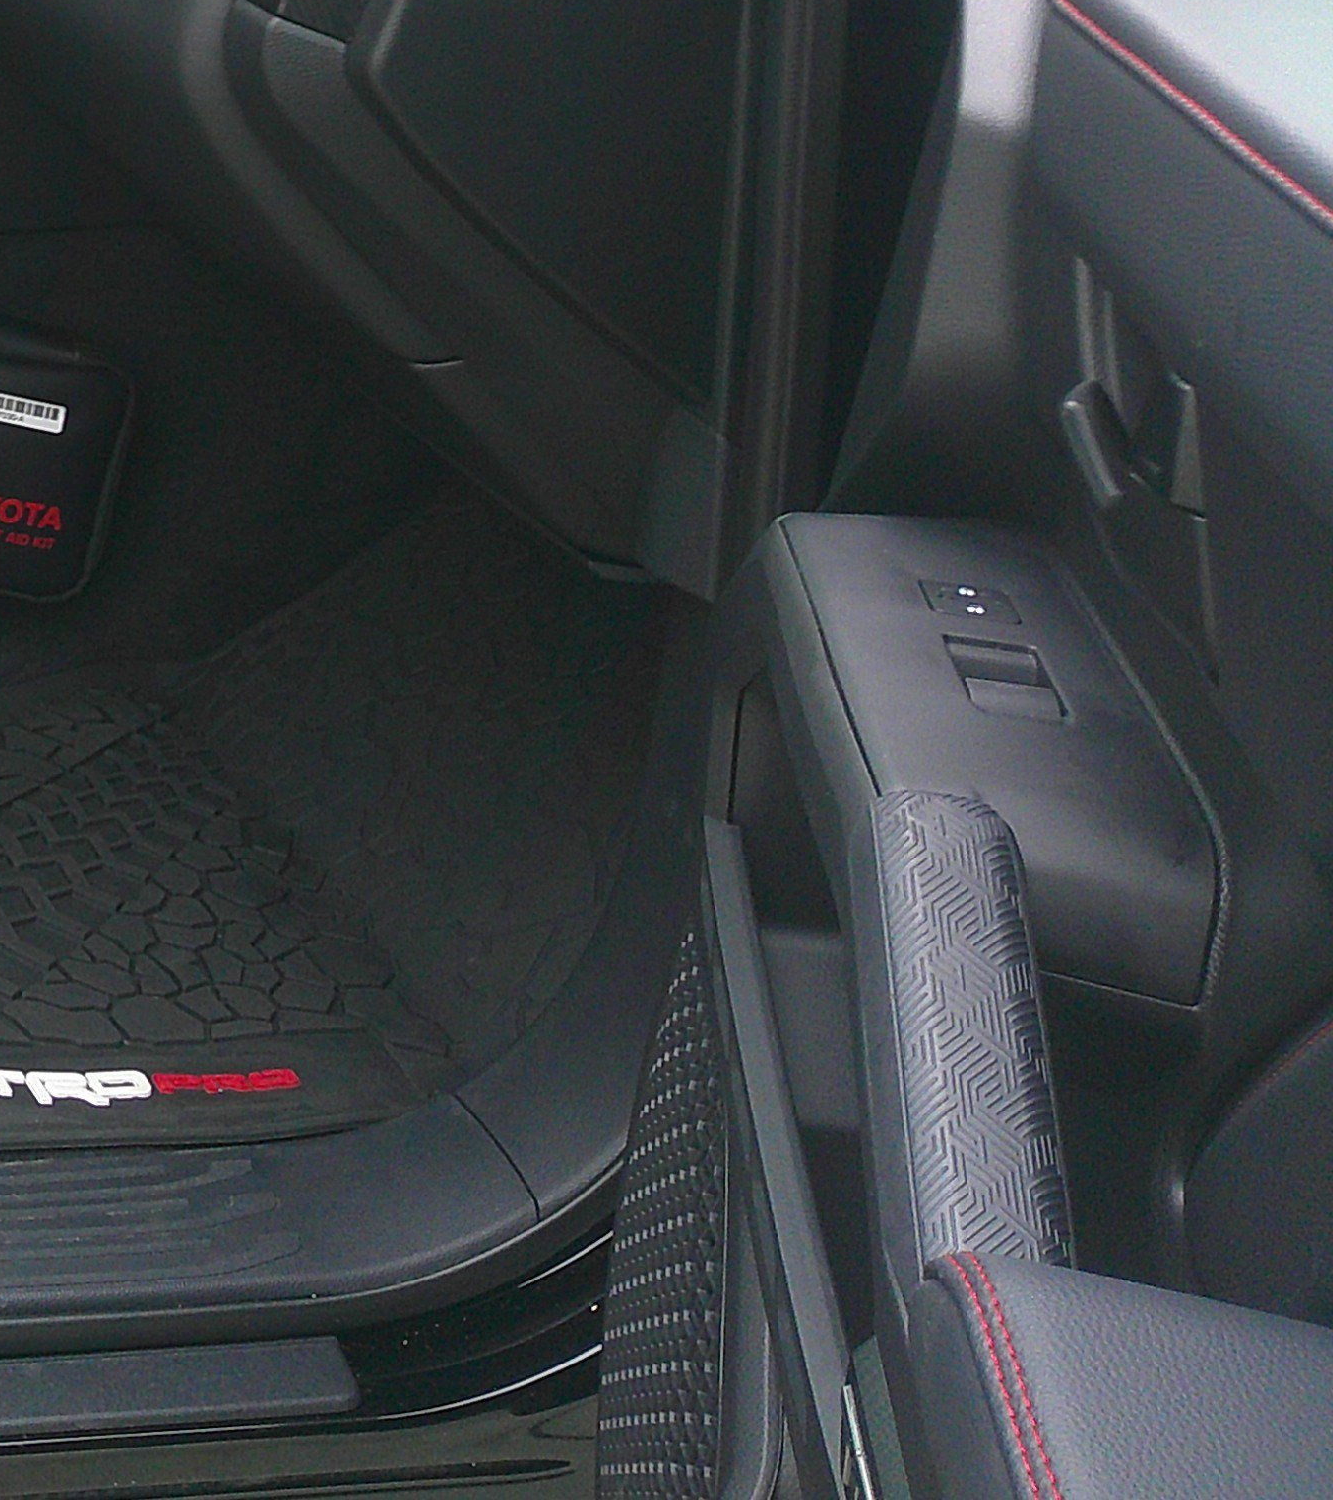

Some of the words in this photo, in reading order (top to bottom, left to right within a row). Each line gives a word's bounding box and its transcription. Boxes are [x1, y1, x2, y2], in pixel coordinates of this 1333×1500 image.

[5, 532, 30, 546] AID
[32, 537, 56, 550] KIT
[153, 1068, 301, 1095] PRO
